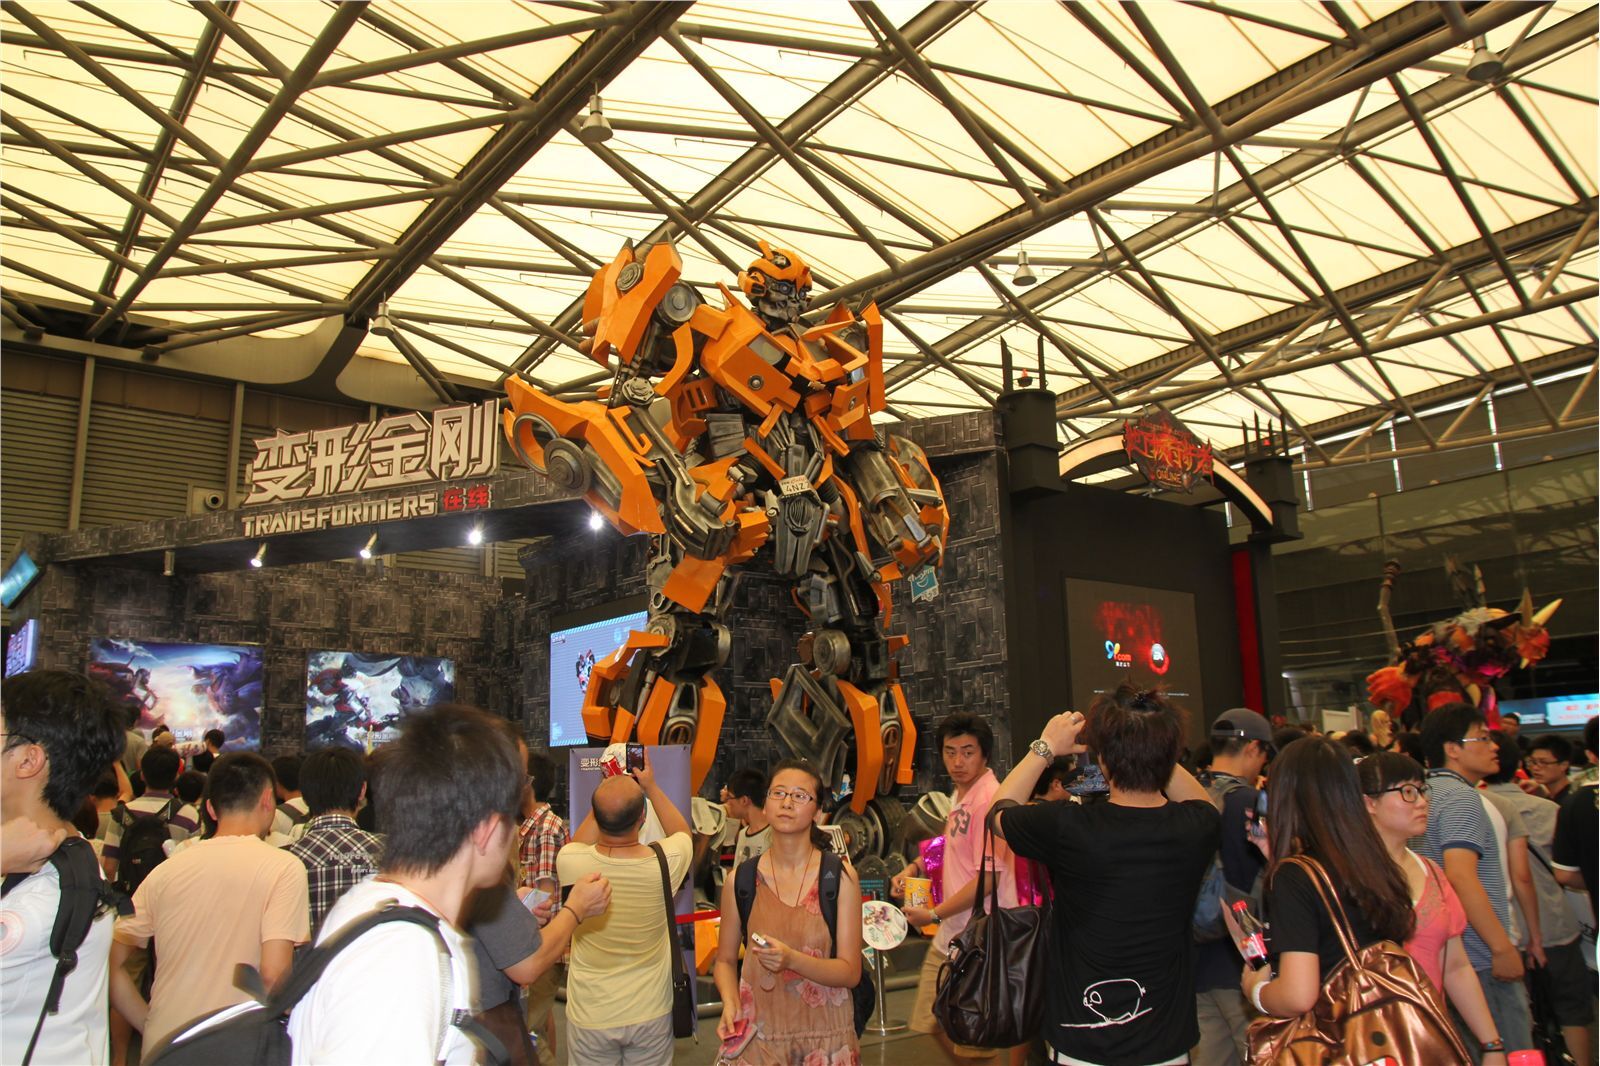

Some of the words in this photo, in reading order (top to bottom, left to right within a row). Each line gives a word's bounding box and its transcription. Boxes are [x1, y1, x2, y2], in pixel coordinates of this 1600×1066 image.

[243, 398, 499, 506] 变形金刚
[242, 493, 437, 537] TRANSFORMERS
[443, 485, 491, 511] 在线
